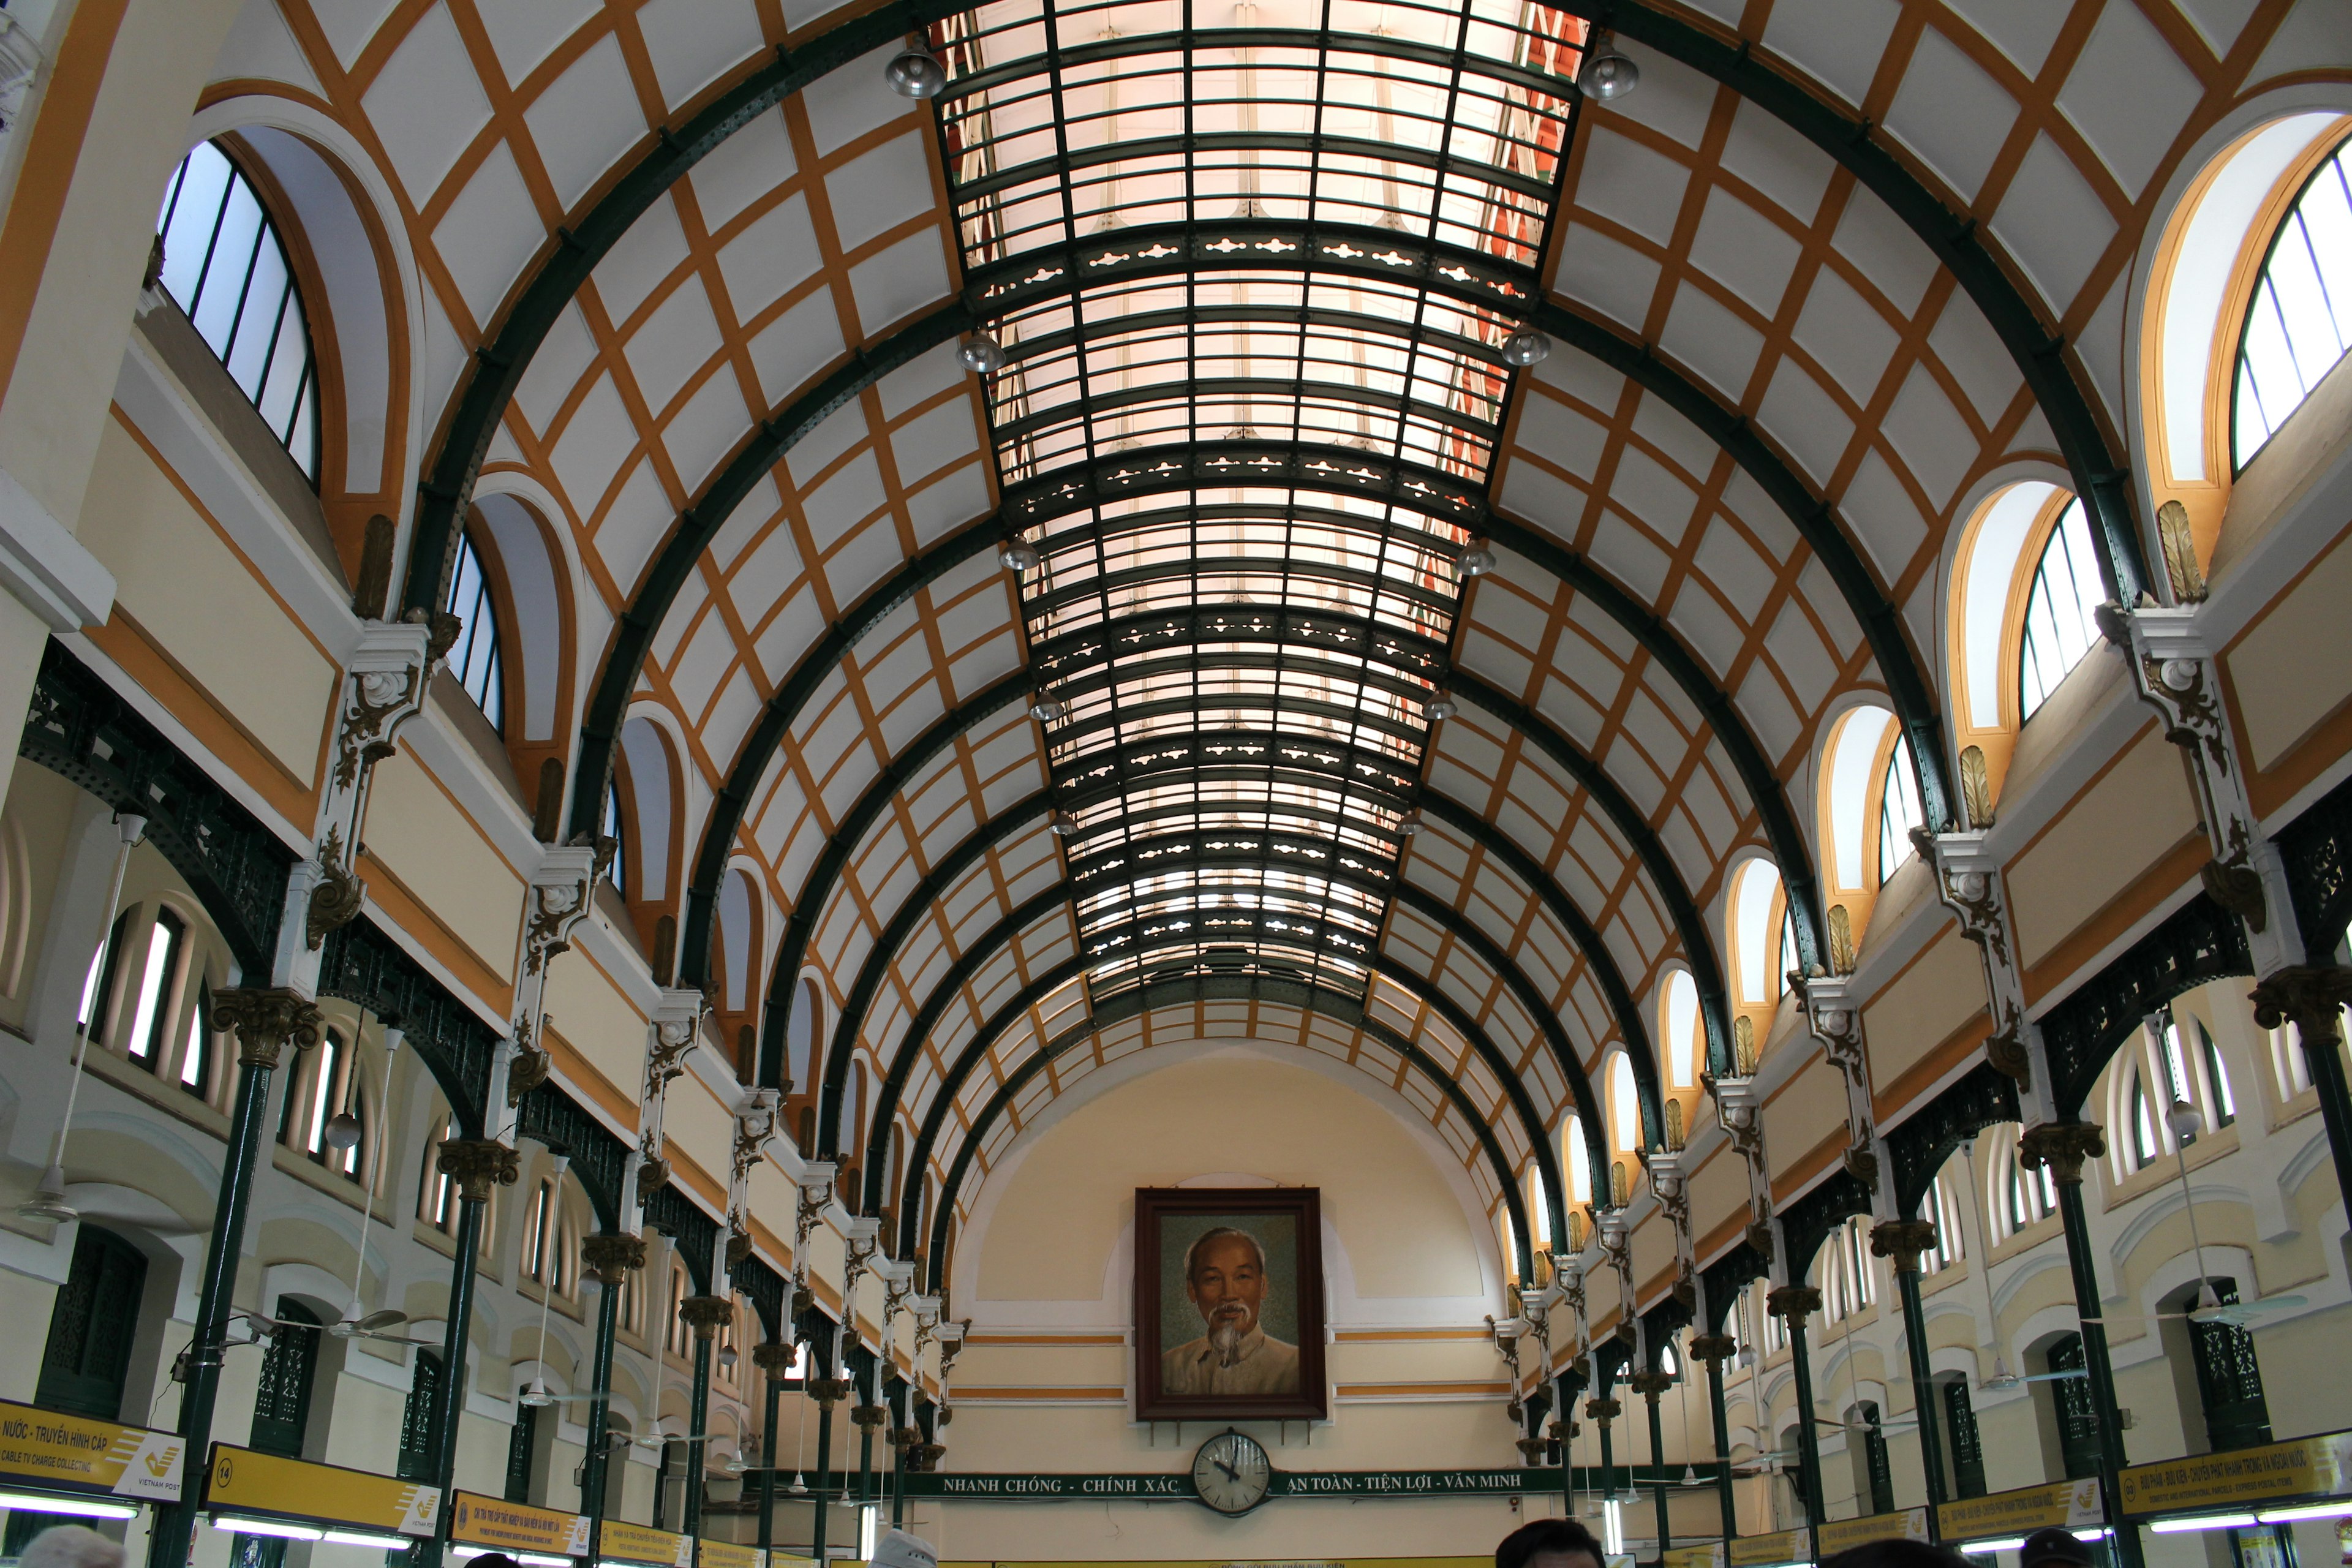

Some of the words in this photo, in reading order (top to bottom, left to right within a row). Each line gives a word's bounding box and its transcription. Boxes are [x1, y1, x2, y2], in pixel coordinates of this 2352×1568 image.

[2, 1419, 28, 1439] NƯỚC
[91, 1433, 107, 1452] CÁP
[1, 1450, 22, 1463] CABLE
[23, 1453, 31, 1463] TV
[32, 1453, 56, 1468] CHARGE
[56, 1458, 91, 1472] COLLECTING
[2242, 1456, 2263, 1474] TRONG
[219, 1468, 230, 1479] 14
[1287, 1478, 1307, 1491] AN
[1311, 1474, 1352, 1490] TOÀN
[1365, 1473, 1401, 1491] TIỆN
[1406, 1475, 1431, 1491] LỢI
[1444, 1472, 1475, 1488] VĂN
[1480, 1474, 1521, 1487] MINH
[138, 1478, 164, 1488] VIETNAM
[944, 1479, 1000, 1492] NHANH
[1005, 1476, 1062, 1492] CHÓNG
[1083, 1476, 1137, 1492] CHÍNH
[1145, 1476, 1178, 1493] XÁC
[2236, 1481, 2257, 1492] EXPRESS
[2258, 1479, 2277, 1489] POSTAL
